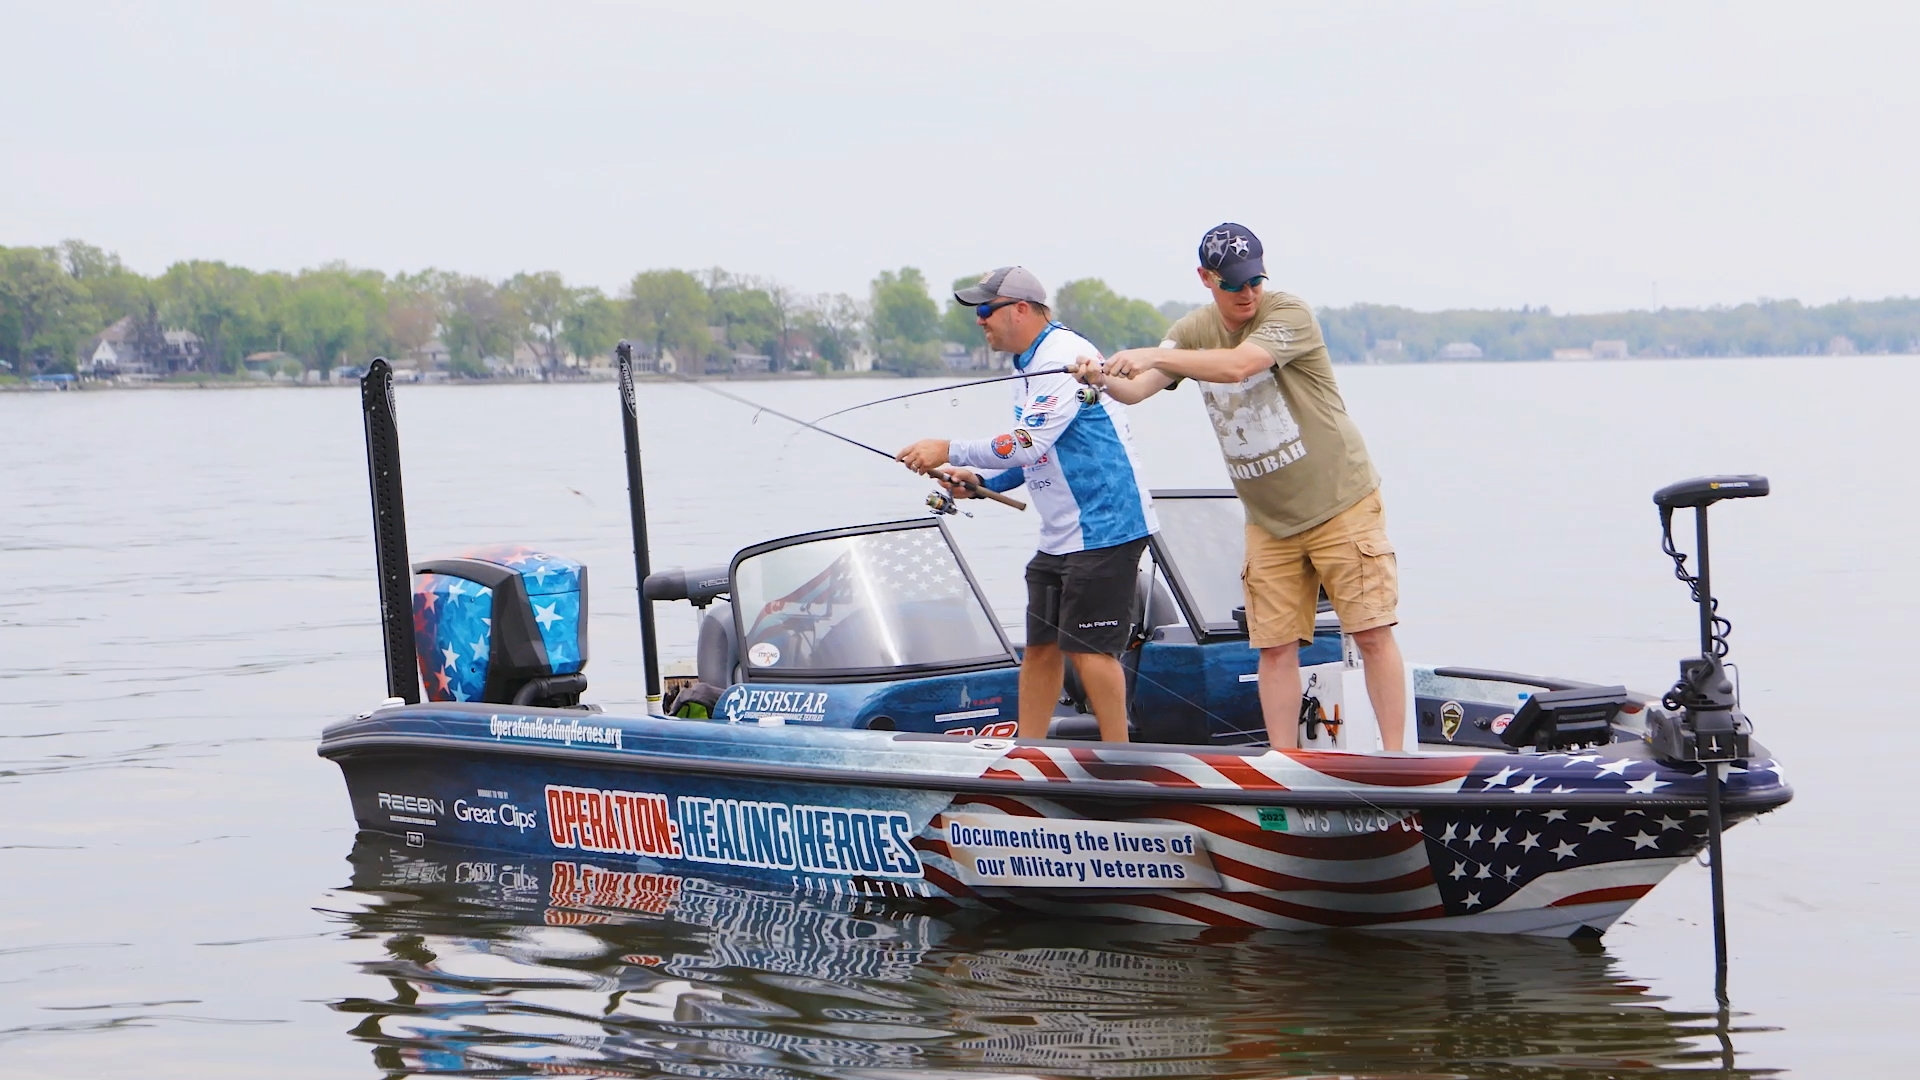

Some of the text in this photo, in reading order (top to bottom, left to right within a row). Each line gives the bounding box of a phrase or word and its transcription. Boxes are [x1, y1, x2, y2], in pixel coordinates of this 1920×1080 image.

[1228, 439, 1307, 480] AQUBAH
[699, 577, 729, 589] RECO
[490, 714, 623, 750] OperationHealingHeroes.org
[378, 792, 445, 815] RECON
[453, 799, 537, 834] Great Clips
[1260, 813, 1286, 822] 2023
[546, 787, 922, 876] OPERATION: HEALING HEROES
[951, 822, 1193, 855] Documenting the lives of
[976, 855, 1186, 882] our Military Veterans
[791, 875, 932, 898] FOUNDATION
